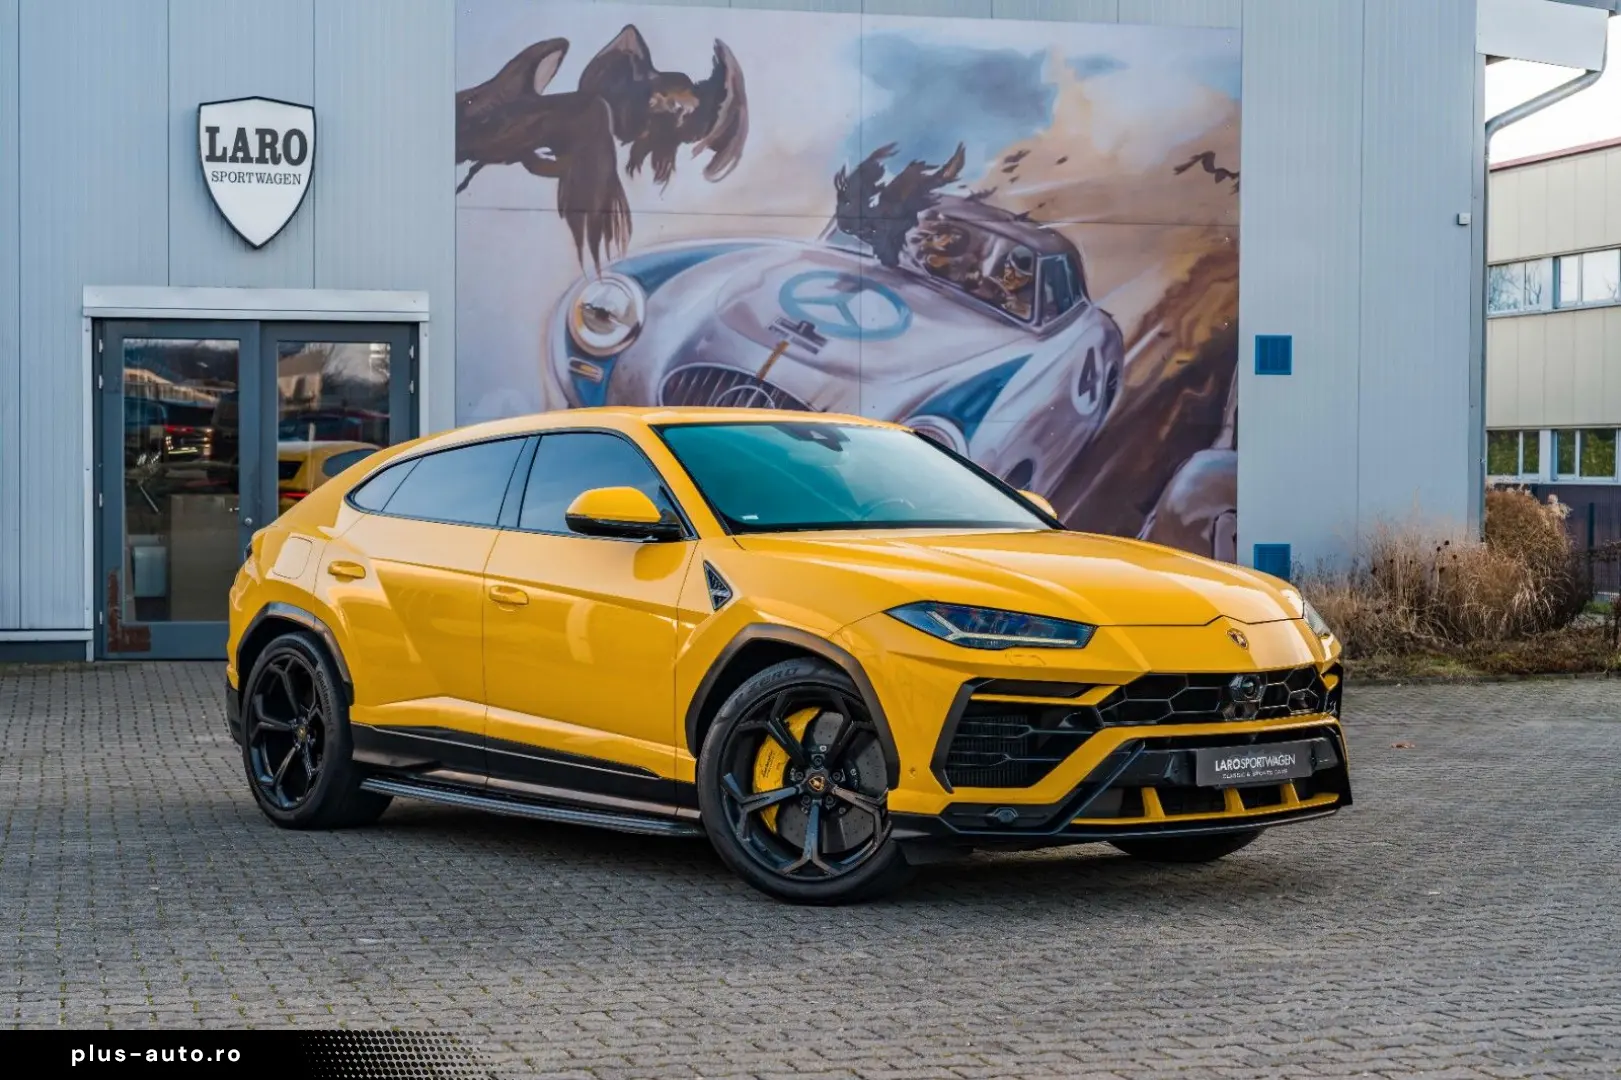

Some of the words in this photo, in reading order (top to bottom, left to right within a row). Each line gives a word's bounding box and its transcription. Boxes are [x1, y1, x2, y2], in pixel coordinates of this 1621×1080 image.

[205, 126, 308, 166] LARO
[211, 170, 302, 185] SPORTWAGEN
[1078, 346, 1101, 404] 4
